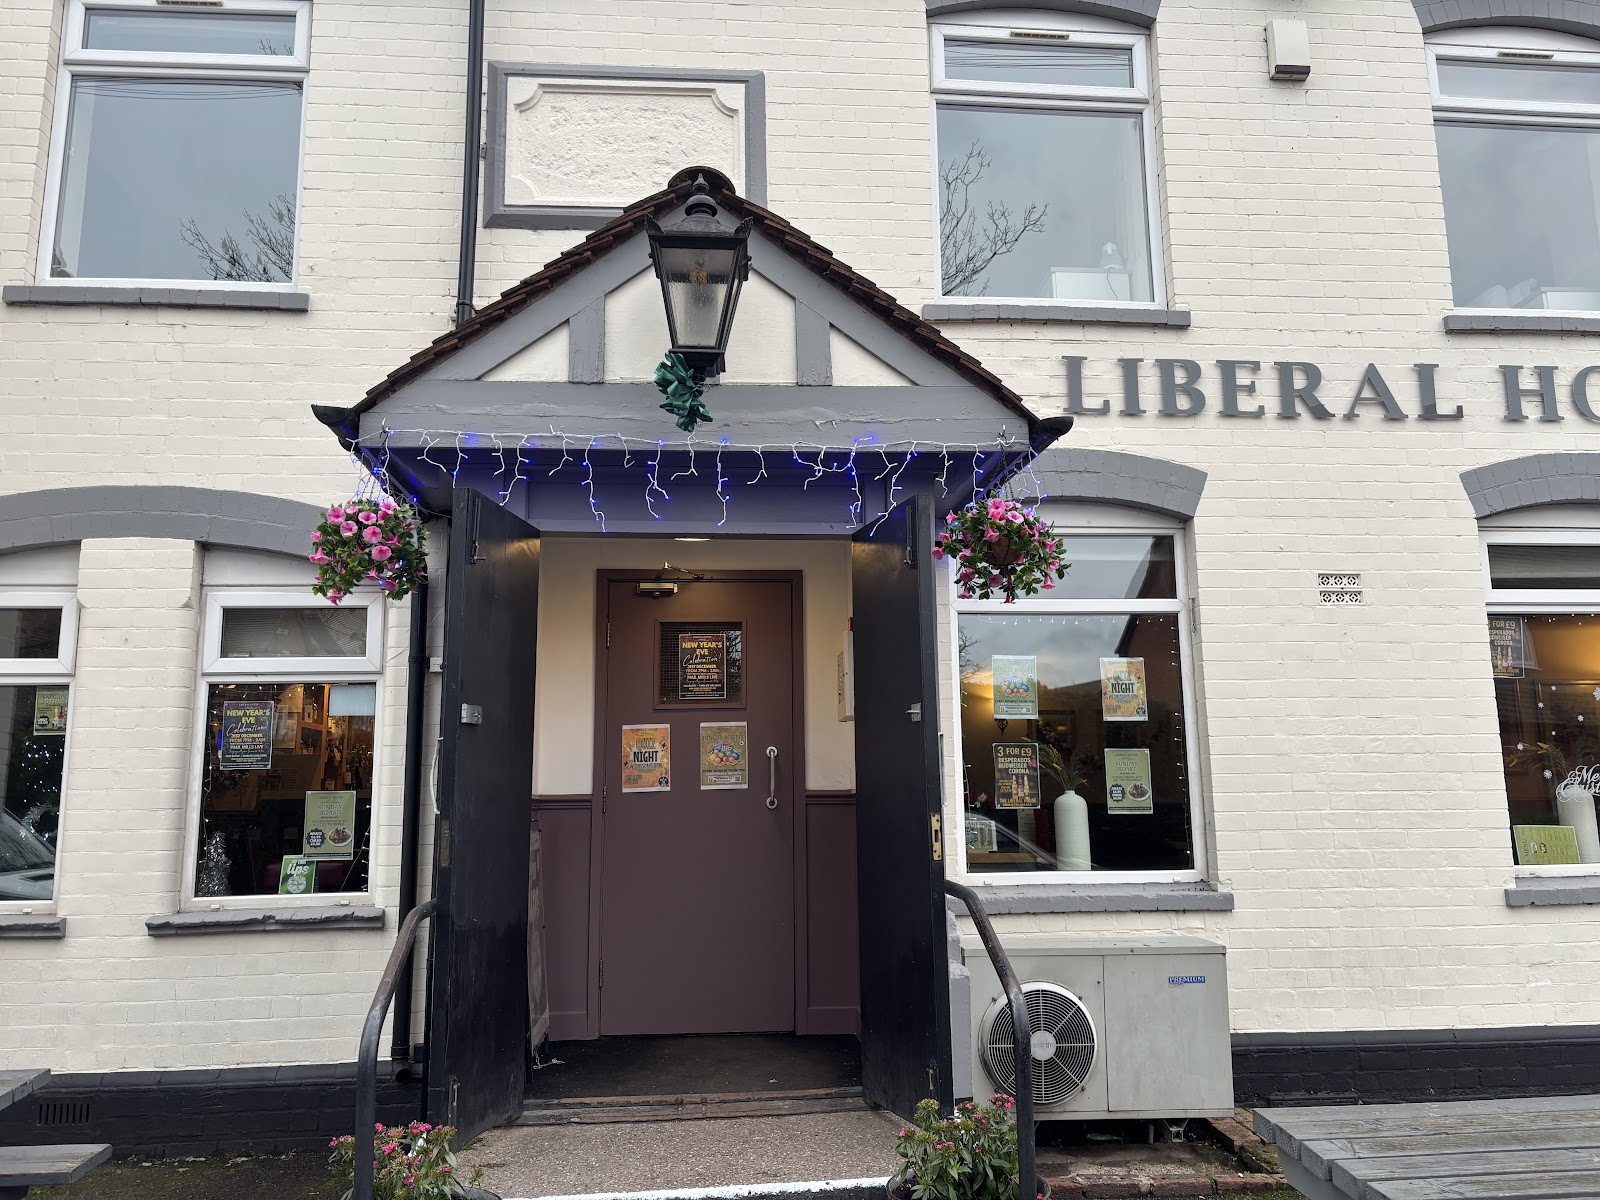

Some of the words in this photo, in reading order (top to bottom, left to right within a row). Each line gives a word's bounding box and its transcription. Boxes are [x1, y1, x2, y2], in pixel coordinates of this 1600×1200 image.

[1062, 356, 1464, 420] LIBERAL
[1506, 621, 1516, 630] £9
[1112, 683, 1134, 693] NIGHT
[633, 751, 658, 762] NIGHT
[998, 746, 1004, 757] 3
[1021, 748, 1032, 756] £9
